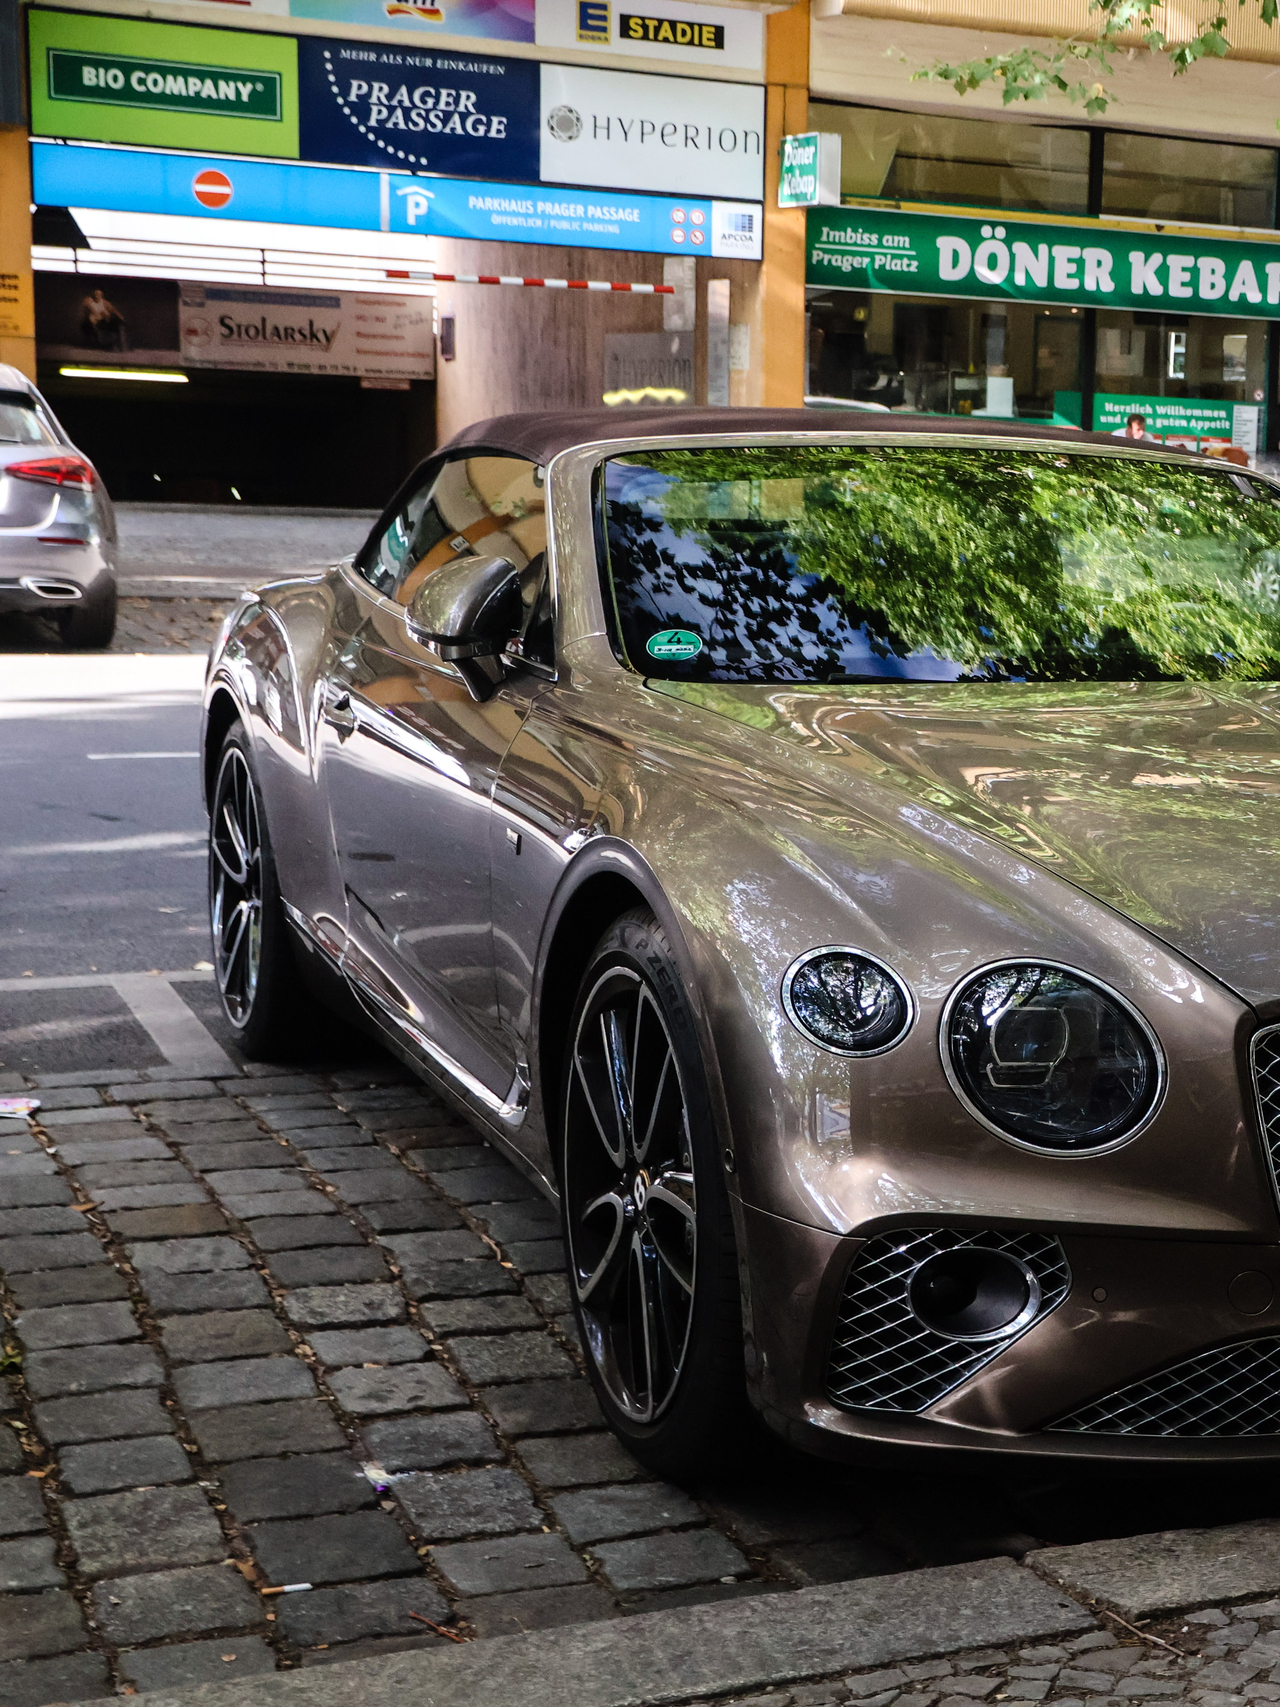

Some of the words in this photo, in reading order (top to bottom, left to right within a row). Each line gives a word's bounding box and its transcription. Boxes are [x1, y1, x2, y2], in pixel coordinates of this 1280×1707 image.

[628, 16, 716, 47] STADIE
[340, 49, 377, 62] MEHR
[380, 53, 402, 65] ALS
[406, 56, 433, 68] NUR
[436, 59, 505, 75] EINKAUFEN
[82, 65, 125, 90] BIO
[348, 79, 477, 113] PRAGER
[367, 104, 507, 139] PASSAGE
[784, 141, 815, 167] Döner
[783, 168, 815, 200] Kebap
[468, 195, 534, 213] PARKHAUS
[536, 201, 584, 218] PRAGER
[587, 206, 640, 222] PASSAGE
[491, 213, 542, 228] ÖFFENTLICH
[550, 219, 580, 231] PUBLIC
[582, 222, 620, 234] PARKING
[721, 233, 754, 242] APCOA
[820, 227, 879, 246] Imbiss
[882, 235, 911, 248] am
[812, 250, 871, 272] Prager
[874, 254, 919, 272] Platz
[936, 224, 1115, 293] DÖNER
[1100, 414, 1121, 424] und
[1155, 417, 1188, 428] guten
[1189, 419, 1231, 430] Appetit
[1104, 402, 1153, 414] Herzlich
[1155, 405, 1227, 418] Willkommen
[667, 631, 682, 645] 4
